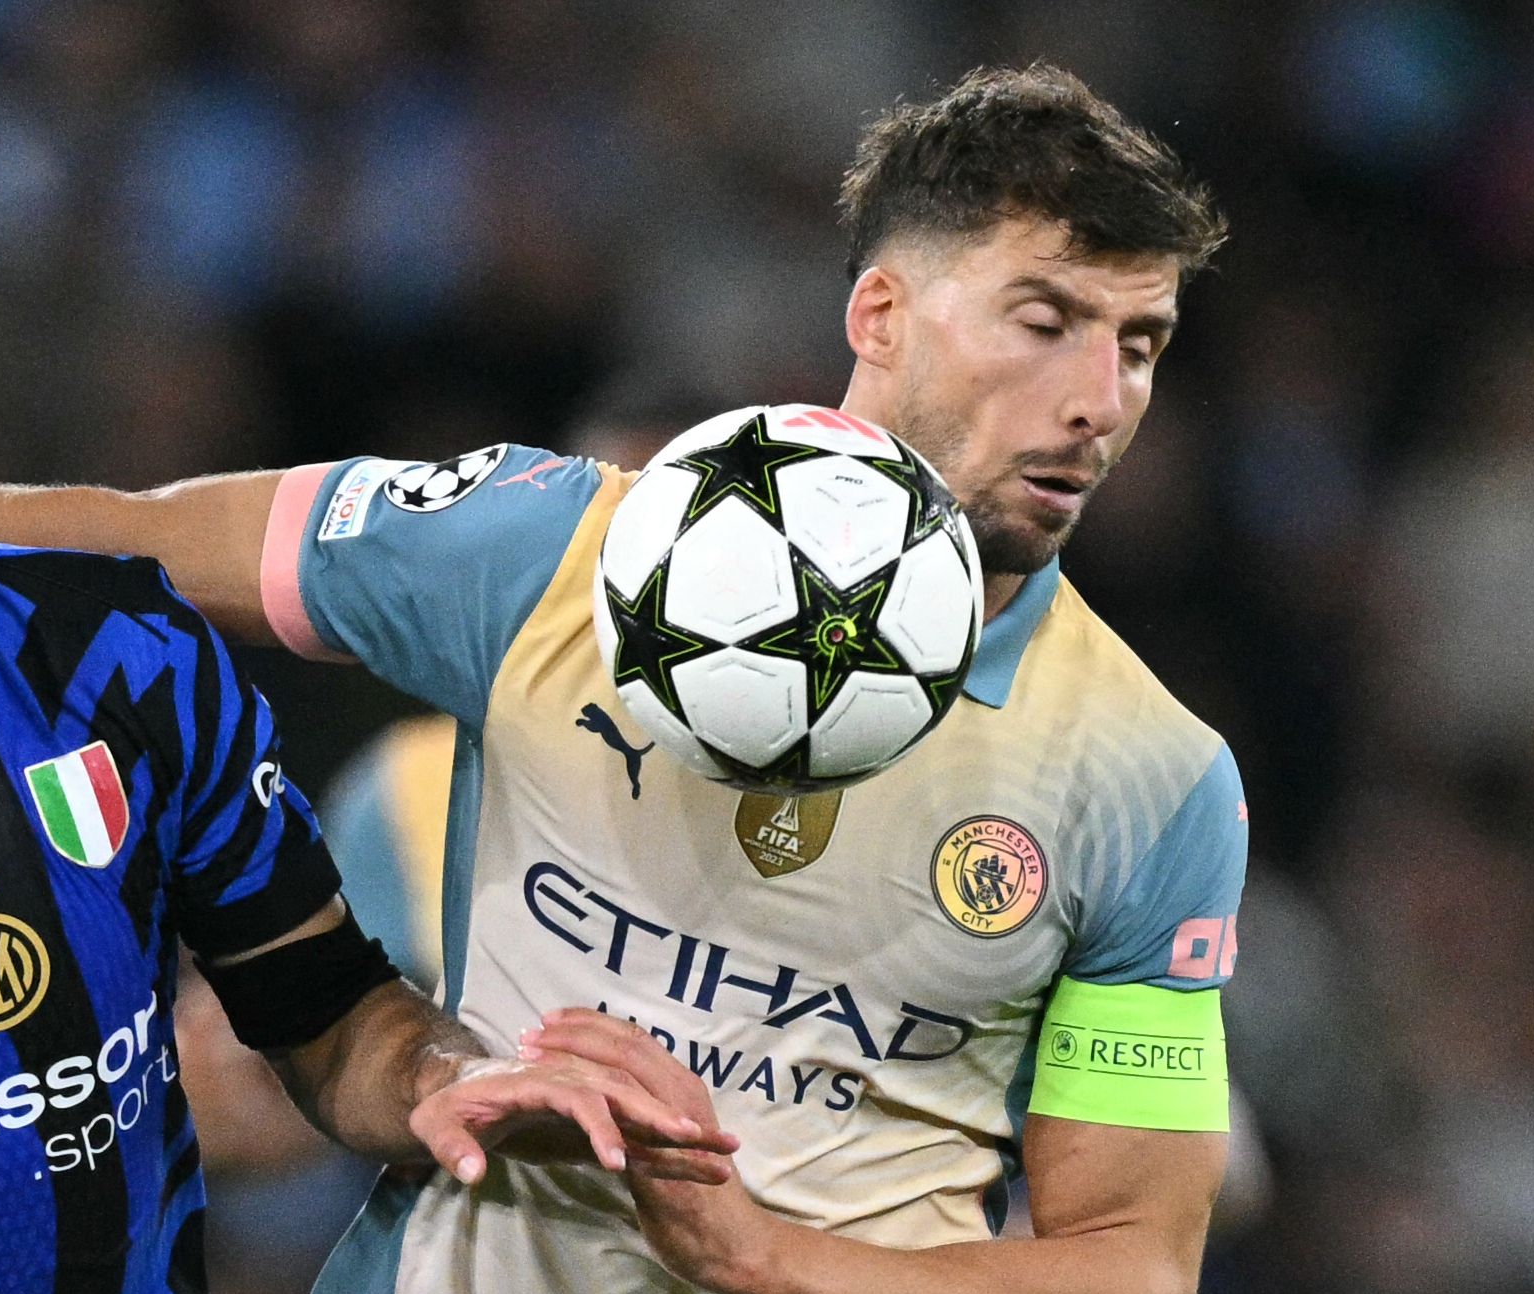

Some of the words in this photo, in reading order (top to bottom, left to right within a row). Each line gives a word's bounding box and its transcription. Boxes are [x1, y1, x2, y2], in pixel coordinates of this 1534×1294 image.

[834, 475, 864, 485] PRO
[757, 825, 799, 854] FIFA
[951, 824, 1039, 875] MANCHESTER
[759, 851, 784, 867] 2023
[961, 911, 994, 929] CITY
[523, 861, 966, 1062] ETIHAD
[596, 1001, 862, 1112] WAYS
[1090, 1038, 1205, 1071] RESPECT
